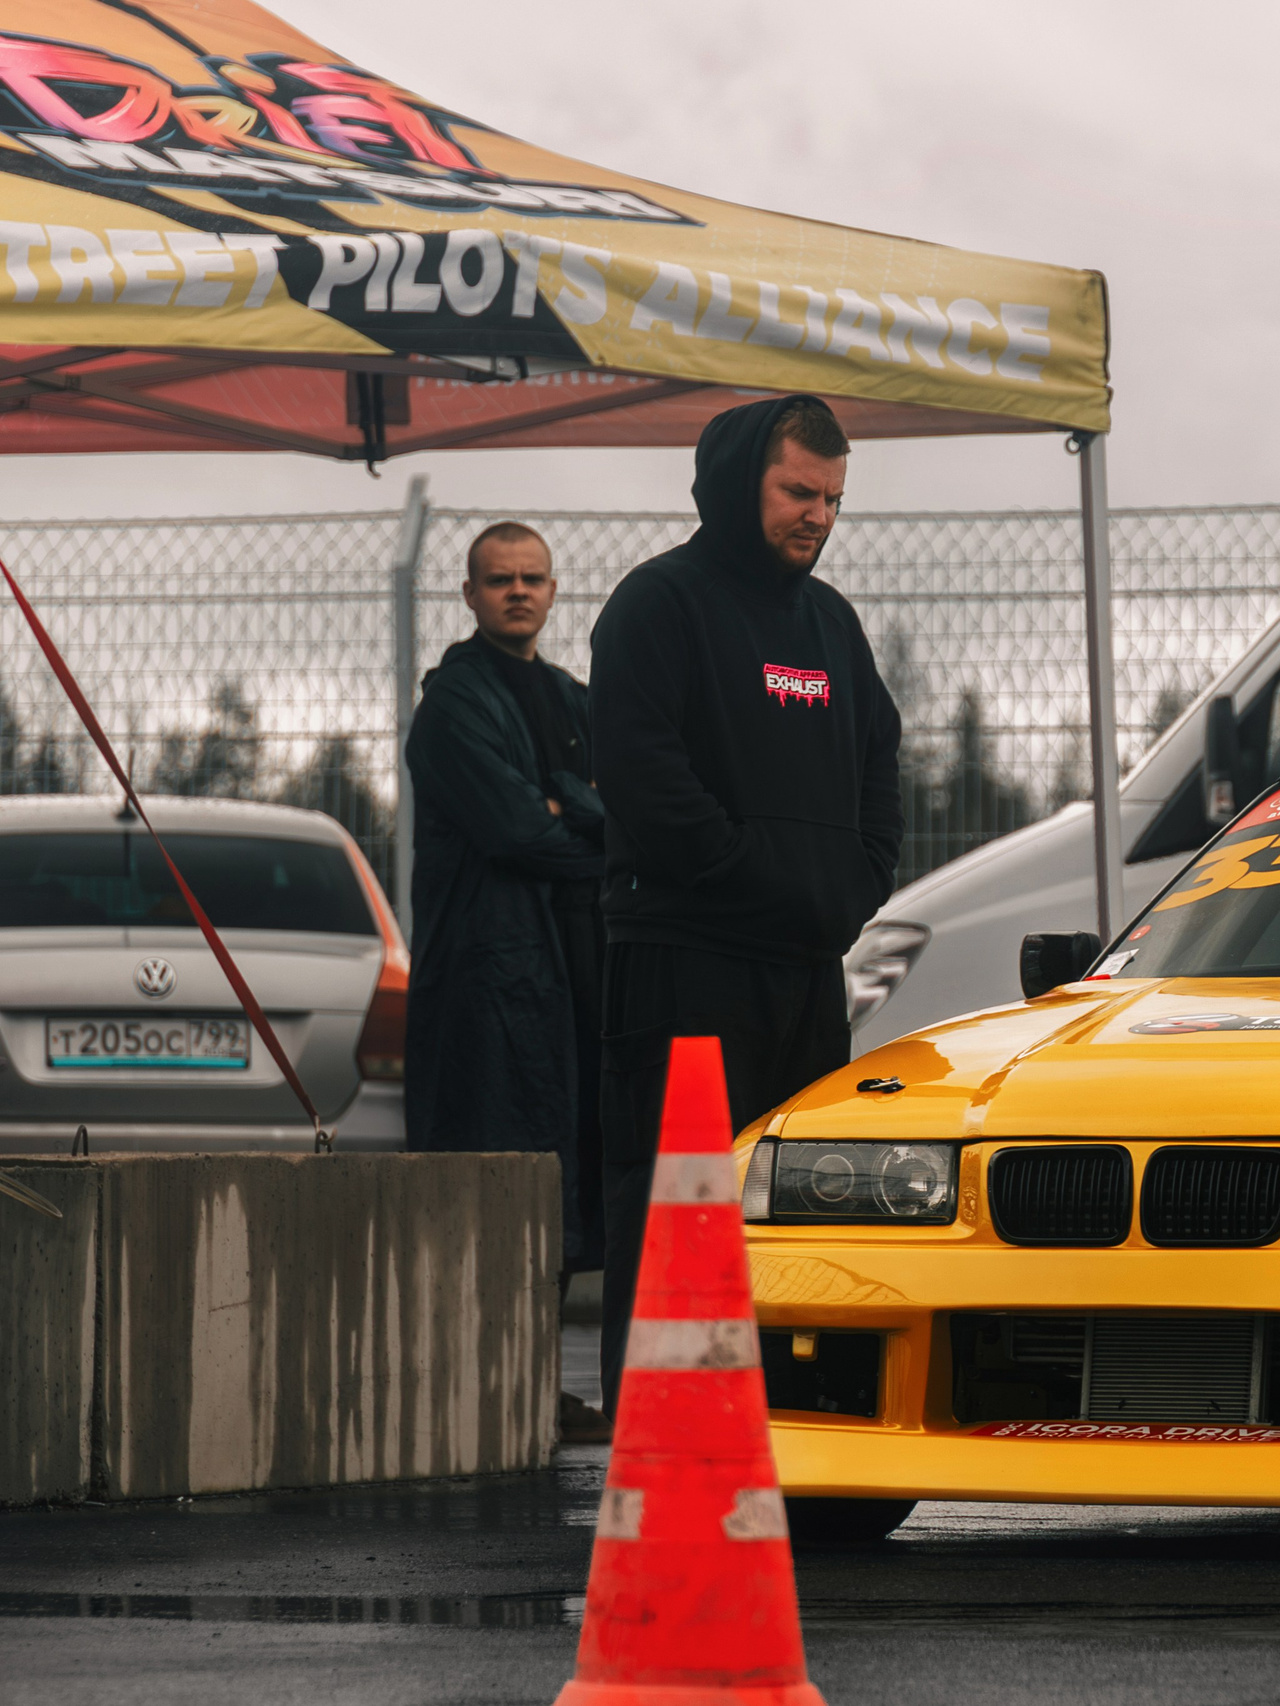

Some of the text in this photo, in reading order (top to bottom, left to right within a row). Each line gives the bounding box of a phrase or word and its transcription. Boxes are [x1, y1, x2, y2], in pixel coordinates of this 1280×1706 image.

[0, 219, 1051, 382] TREET PILOTS ALLIANCE
[766, 673, 827, 695] EXHAUST
[191, 1020, 240, 1048] 799
[1026, 1423, 1151, 1435] IGORA
